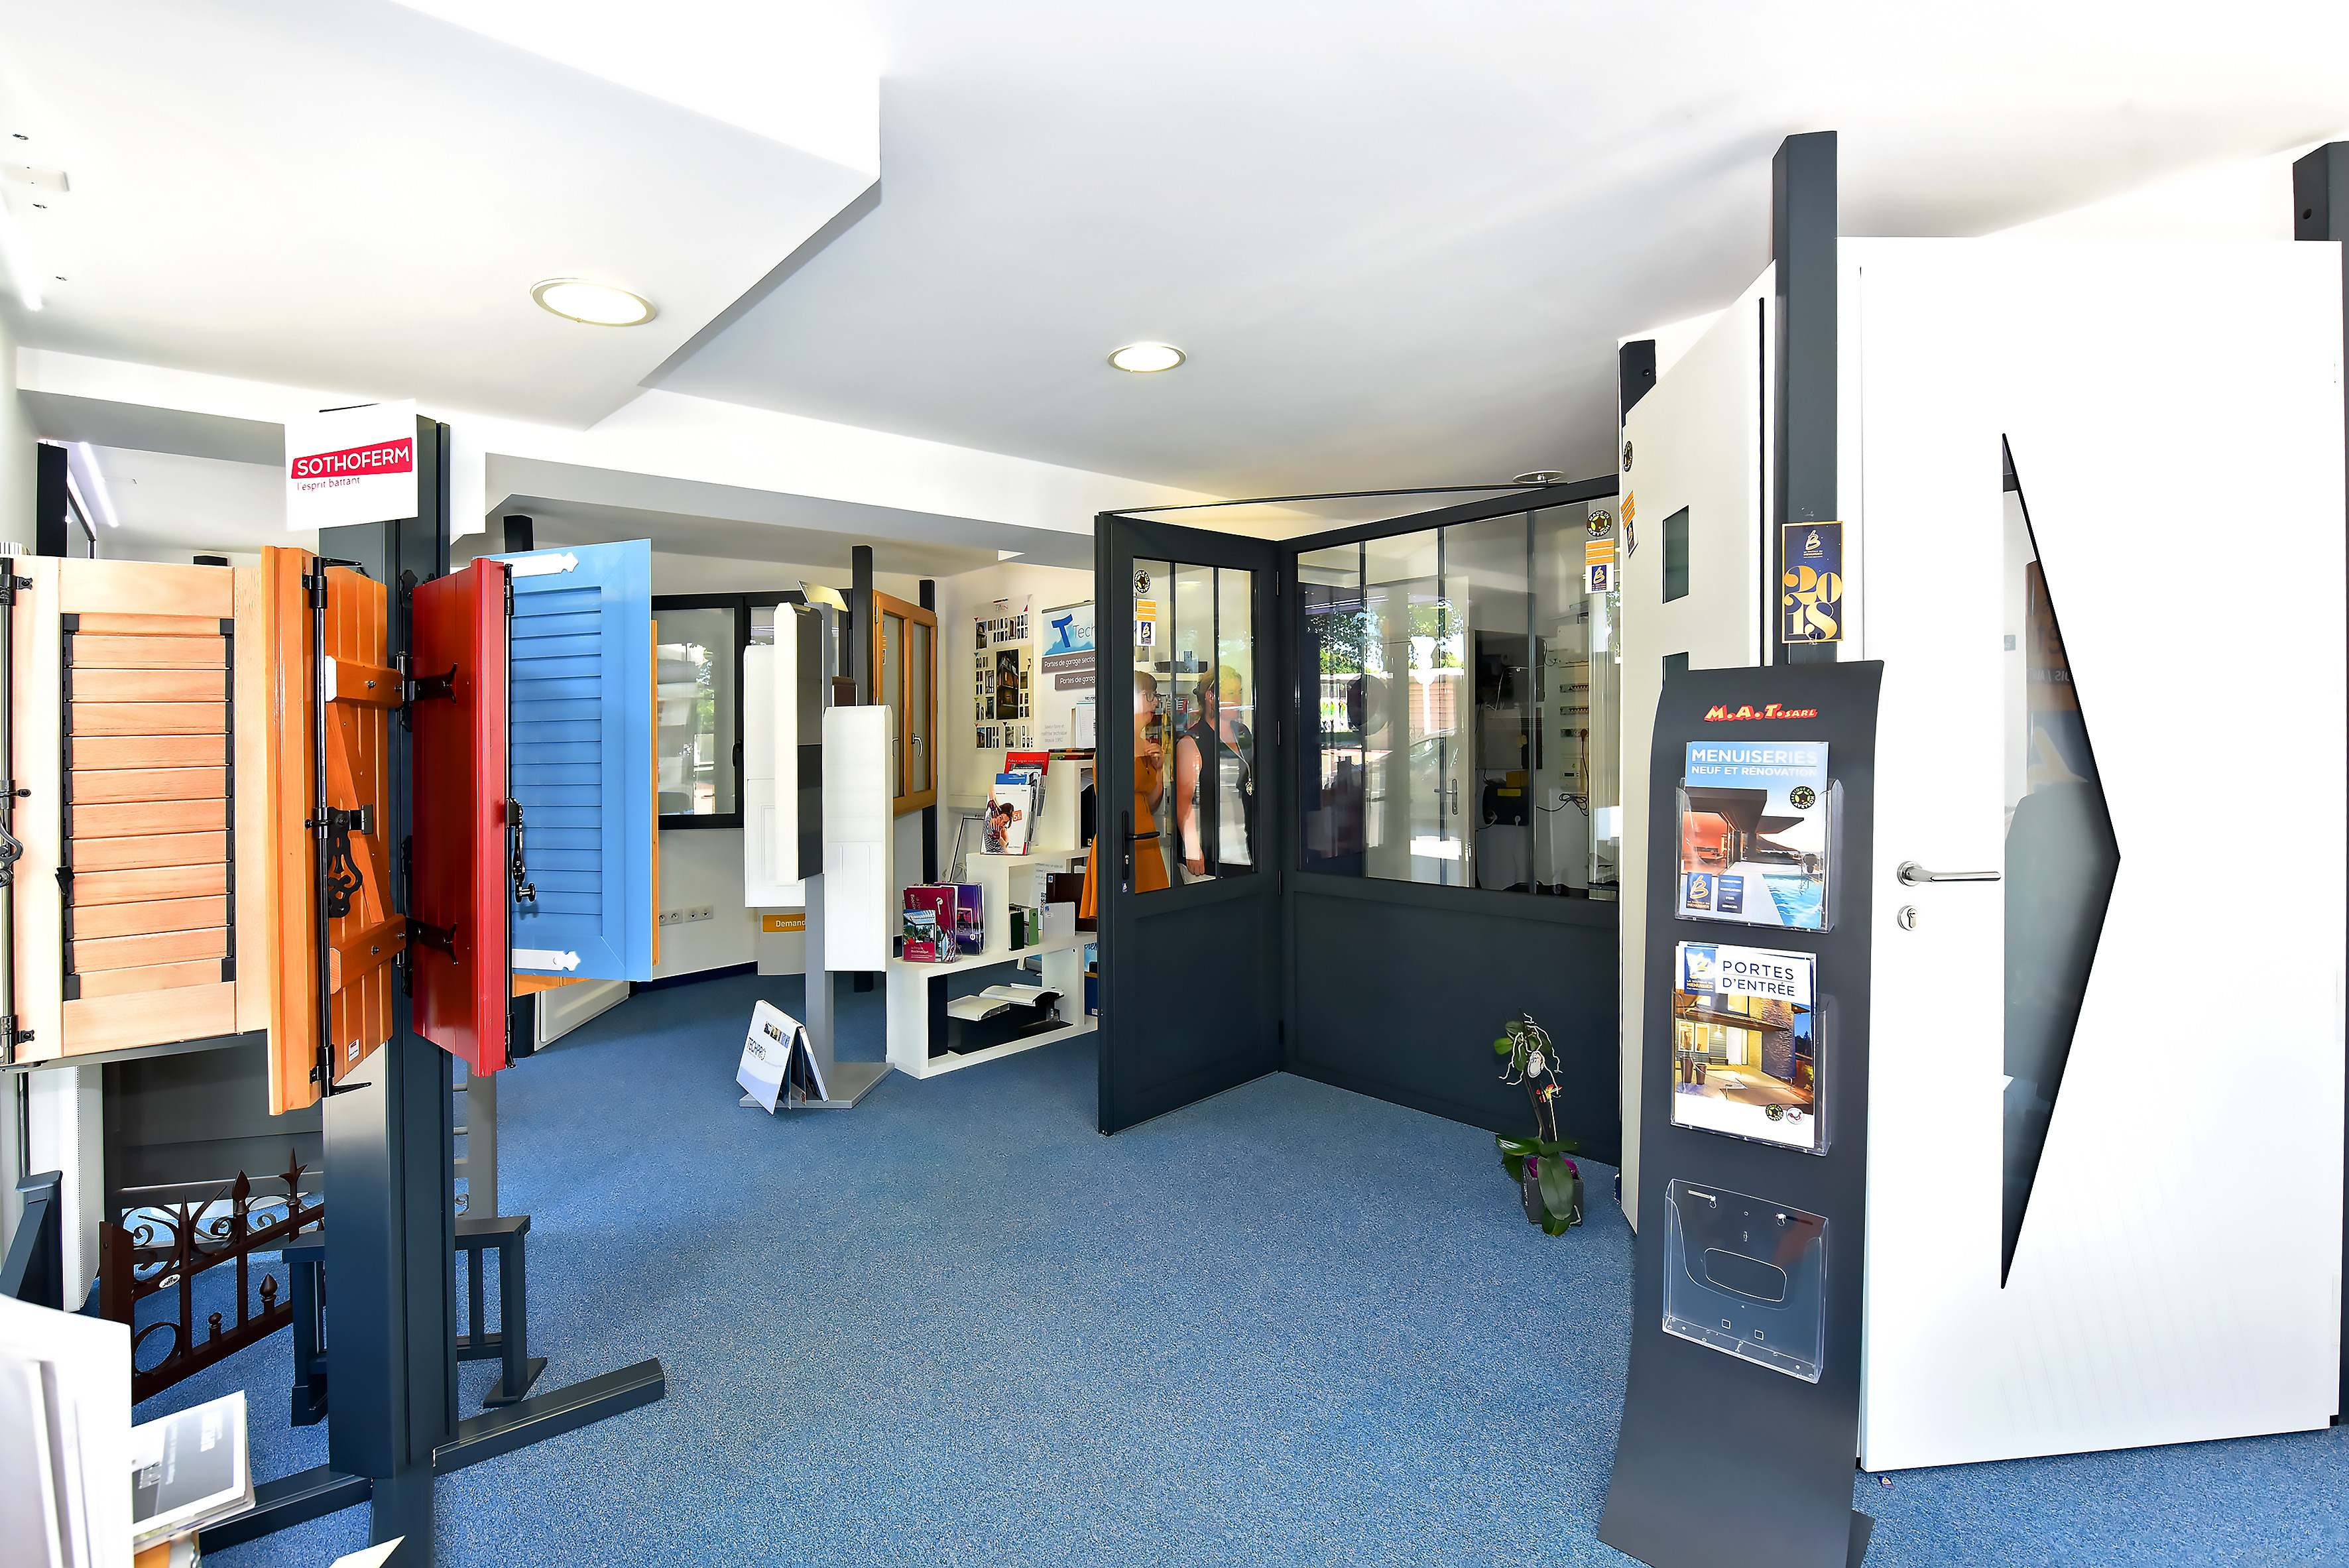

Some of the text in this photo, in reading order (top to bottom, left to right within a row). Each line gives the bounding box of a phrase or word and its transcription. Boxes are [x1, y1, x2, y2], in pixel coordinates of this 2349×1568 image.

[297, 446, 410, 476] SOTHOFERM
[297, 477, 360, 491] l'esprit battant
[1589, 511, 1604, 521] MADE
[1587, 524, 1610, 536] AVEYRON
[1073, 623, 1095, 638] Tech
[1065, 658, 1081, 668] garage
[1691, 749, 1818, 764] MENUISERIES
[1691, 765, 1817, 776] NEUF ET RÉNOVATION
[1722, 960, 1794, 980] PORTES
[1722, 977, 1795, 996] D'ENTRÉE
[747, 1036, 766, 1061] TECHPRO
